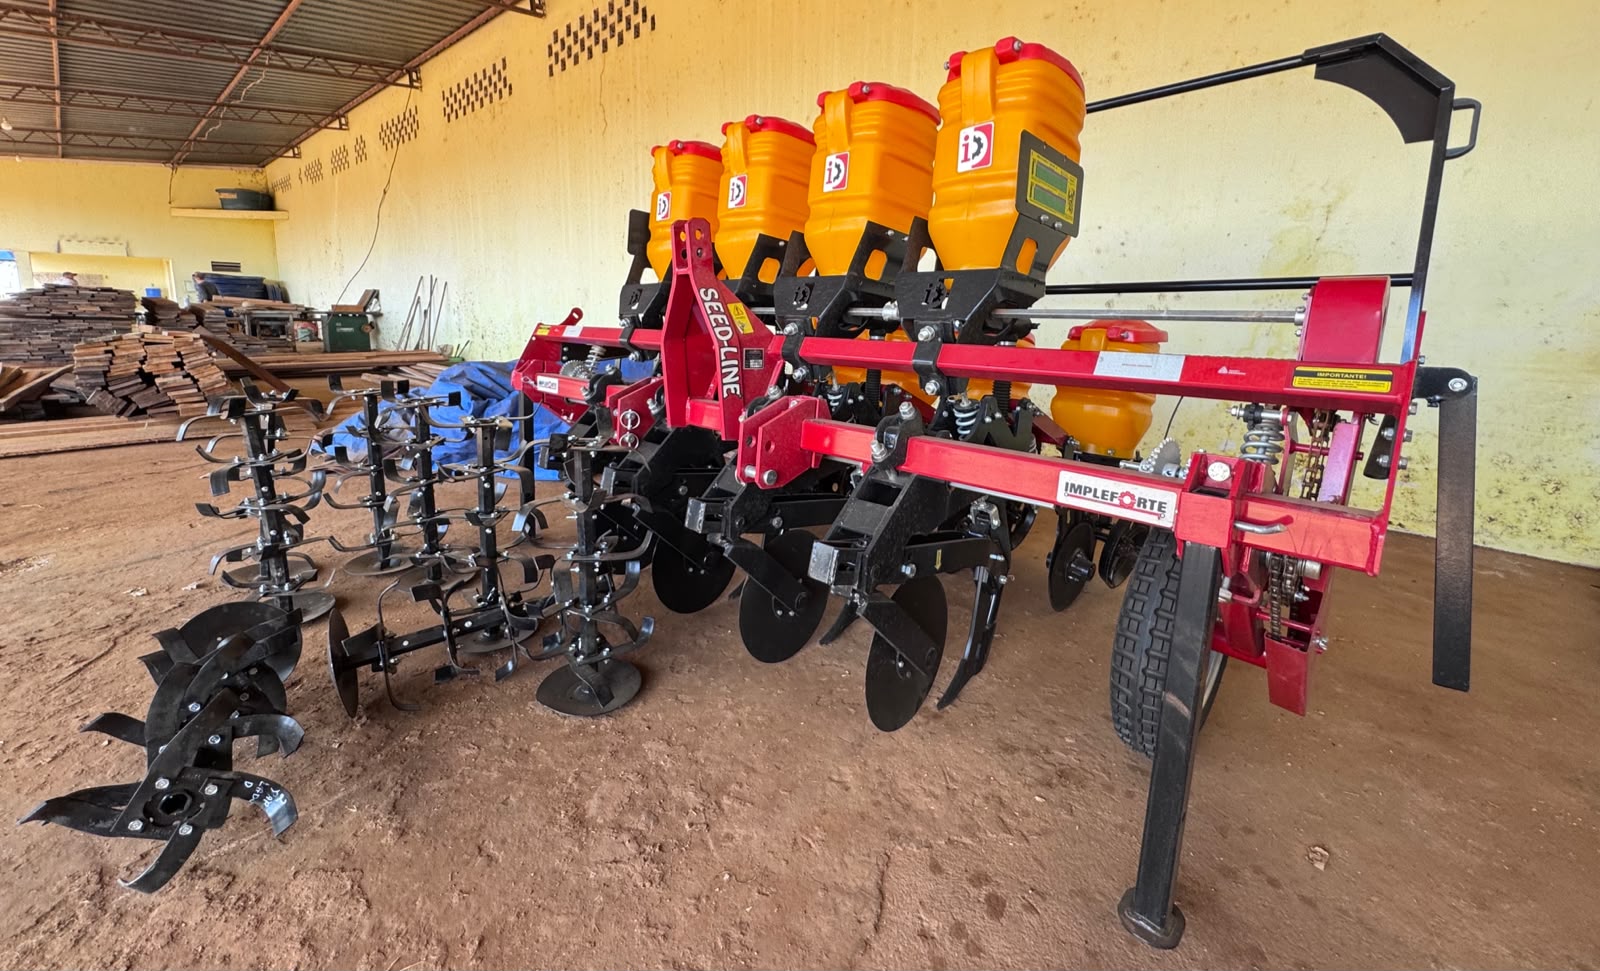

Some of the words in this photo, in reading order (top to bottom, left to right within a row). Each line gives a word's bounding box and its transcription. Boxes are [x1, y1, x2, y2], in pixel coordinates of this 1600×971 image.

[700, 288, 742, 399] SEED-LINE
[1316, 372, 1367, 380] IMPORTANTE!
[1064, 482, 1167, 513] IMPLEFORTE
